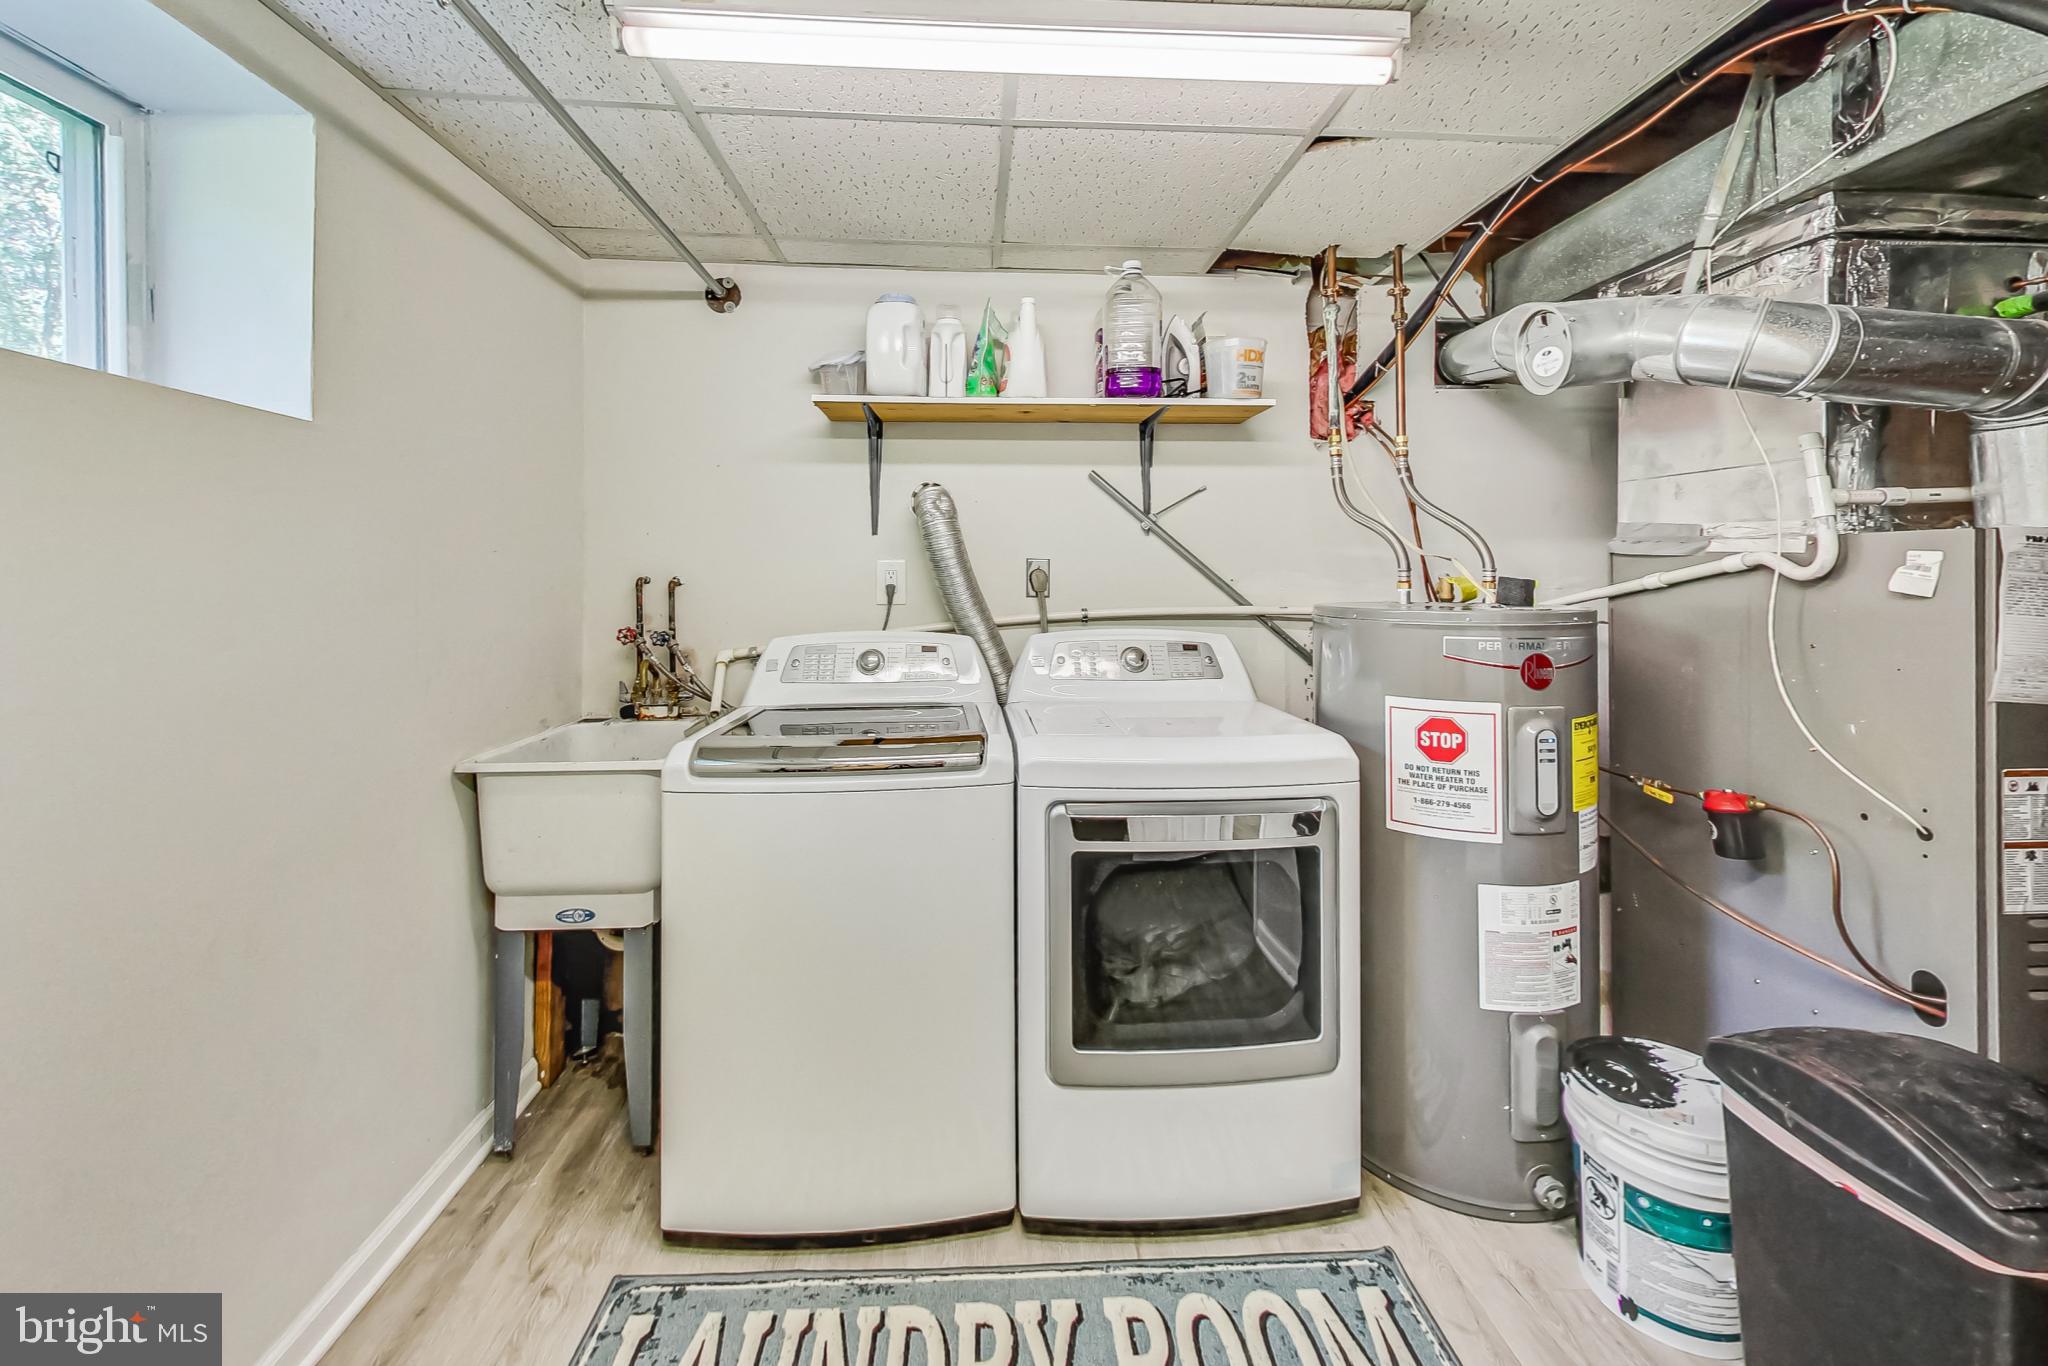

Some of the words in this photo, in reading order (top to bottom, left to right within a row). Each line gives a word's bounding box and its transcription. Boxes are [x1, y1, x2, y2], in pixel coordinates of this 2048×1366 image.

[1420, 731, 1463, 749] STOP
[1404, 763, 1414, 771] DO
[1416, 765, 1430, 773] NOT
[1432, 767, 1461, 776] RETURN
[1463, 769, 1480, 777] THIS
[1397, 777, 1411, 786] THE
[1412, 779, 1435, 789] PLACE
[1437, 783, 1447, 791] OF
[1449, 784, 1488, 794] PURCHASE
[1409, 772, 1434, 781] WATER
[1435, 775, 1464, 785] HEATER
